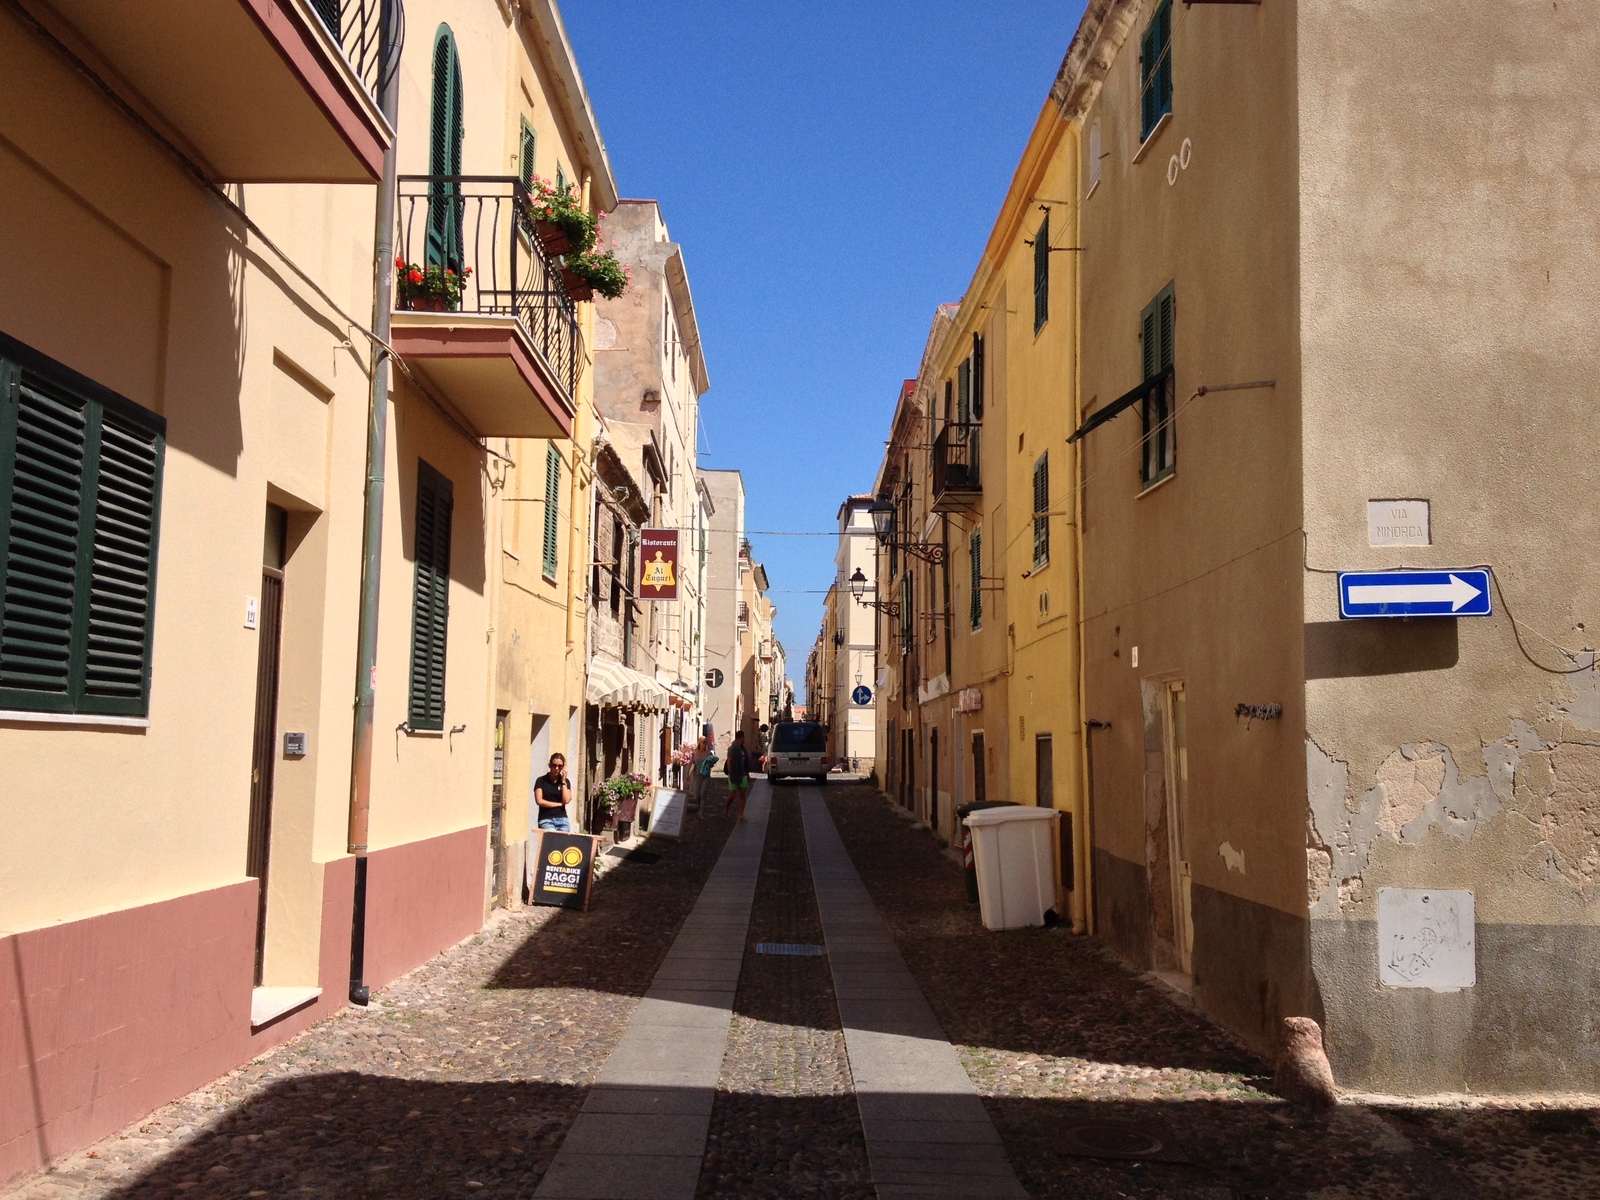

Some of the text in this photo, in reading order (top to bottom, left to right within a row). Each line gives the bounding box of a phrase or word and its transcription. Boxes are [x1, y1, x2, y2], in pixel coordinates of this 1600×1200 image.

[1390, 508, 1408, 520] VIA
[1376, 525, 1423, 538] MINORCA
[642, 538, 677, 546] Ristorante
[654, 567, 664, 575] Al
[545, 865, 581, 875] RENTABIKE
[544, 872, 580, 884] RAGGI
[551, 881, 578, 889] SARDEGNA
